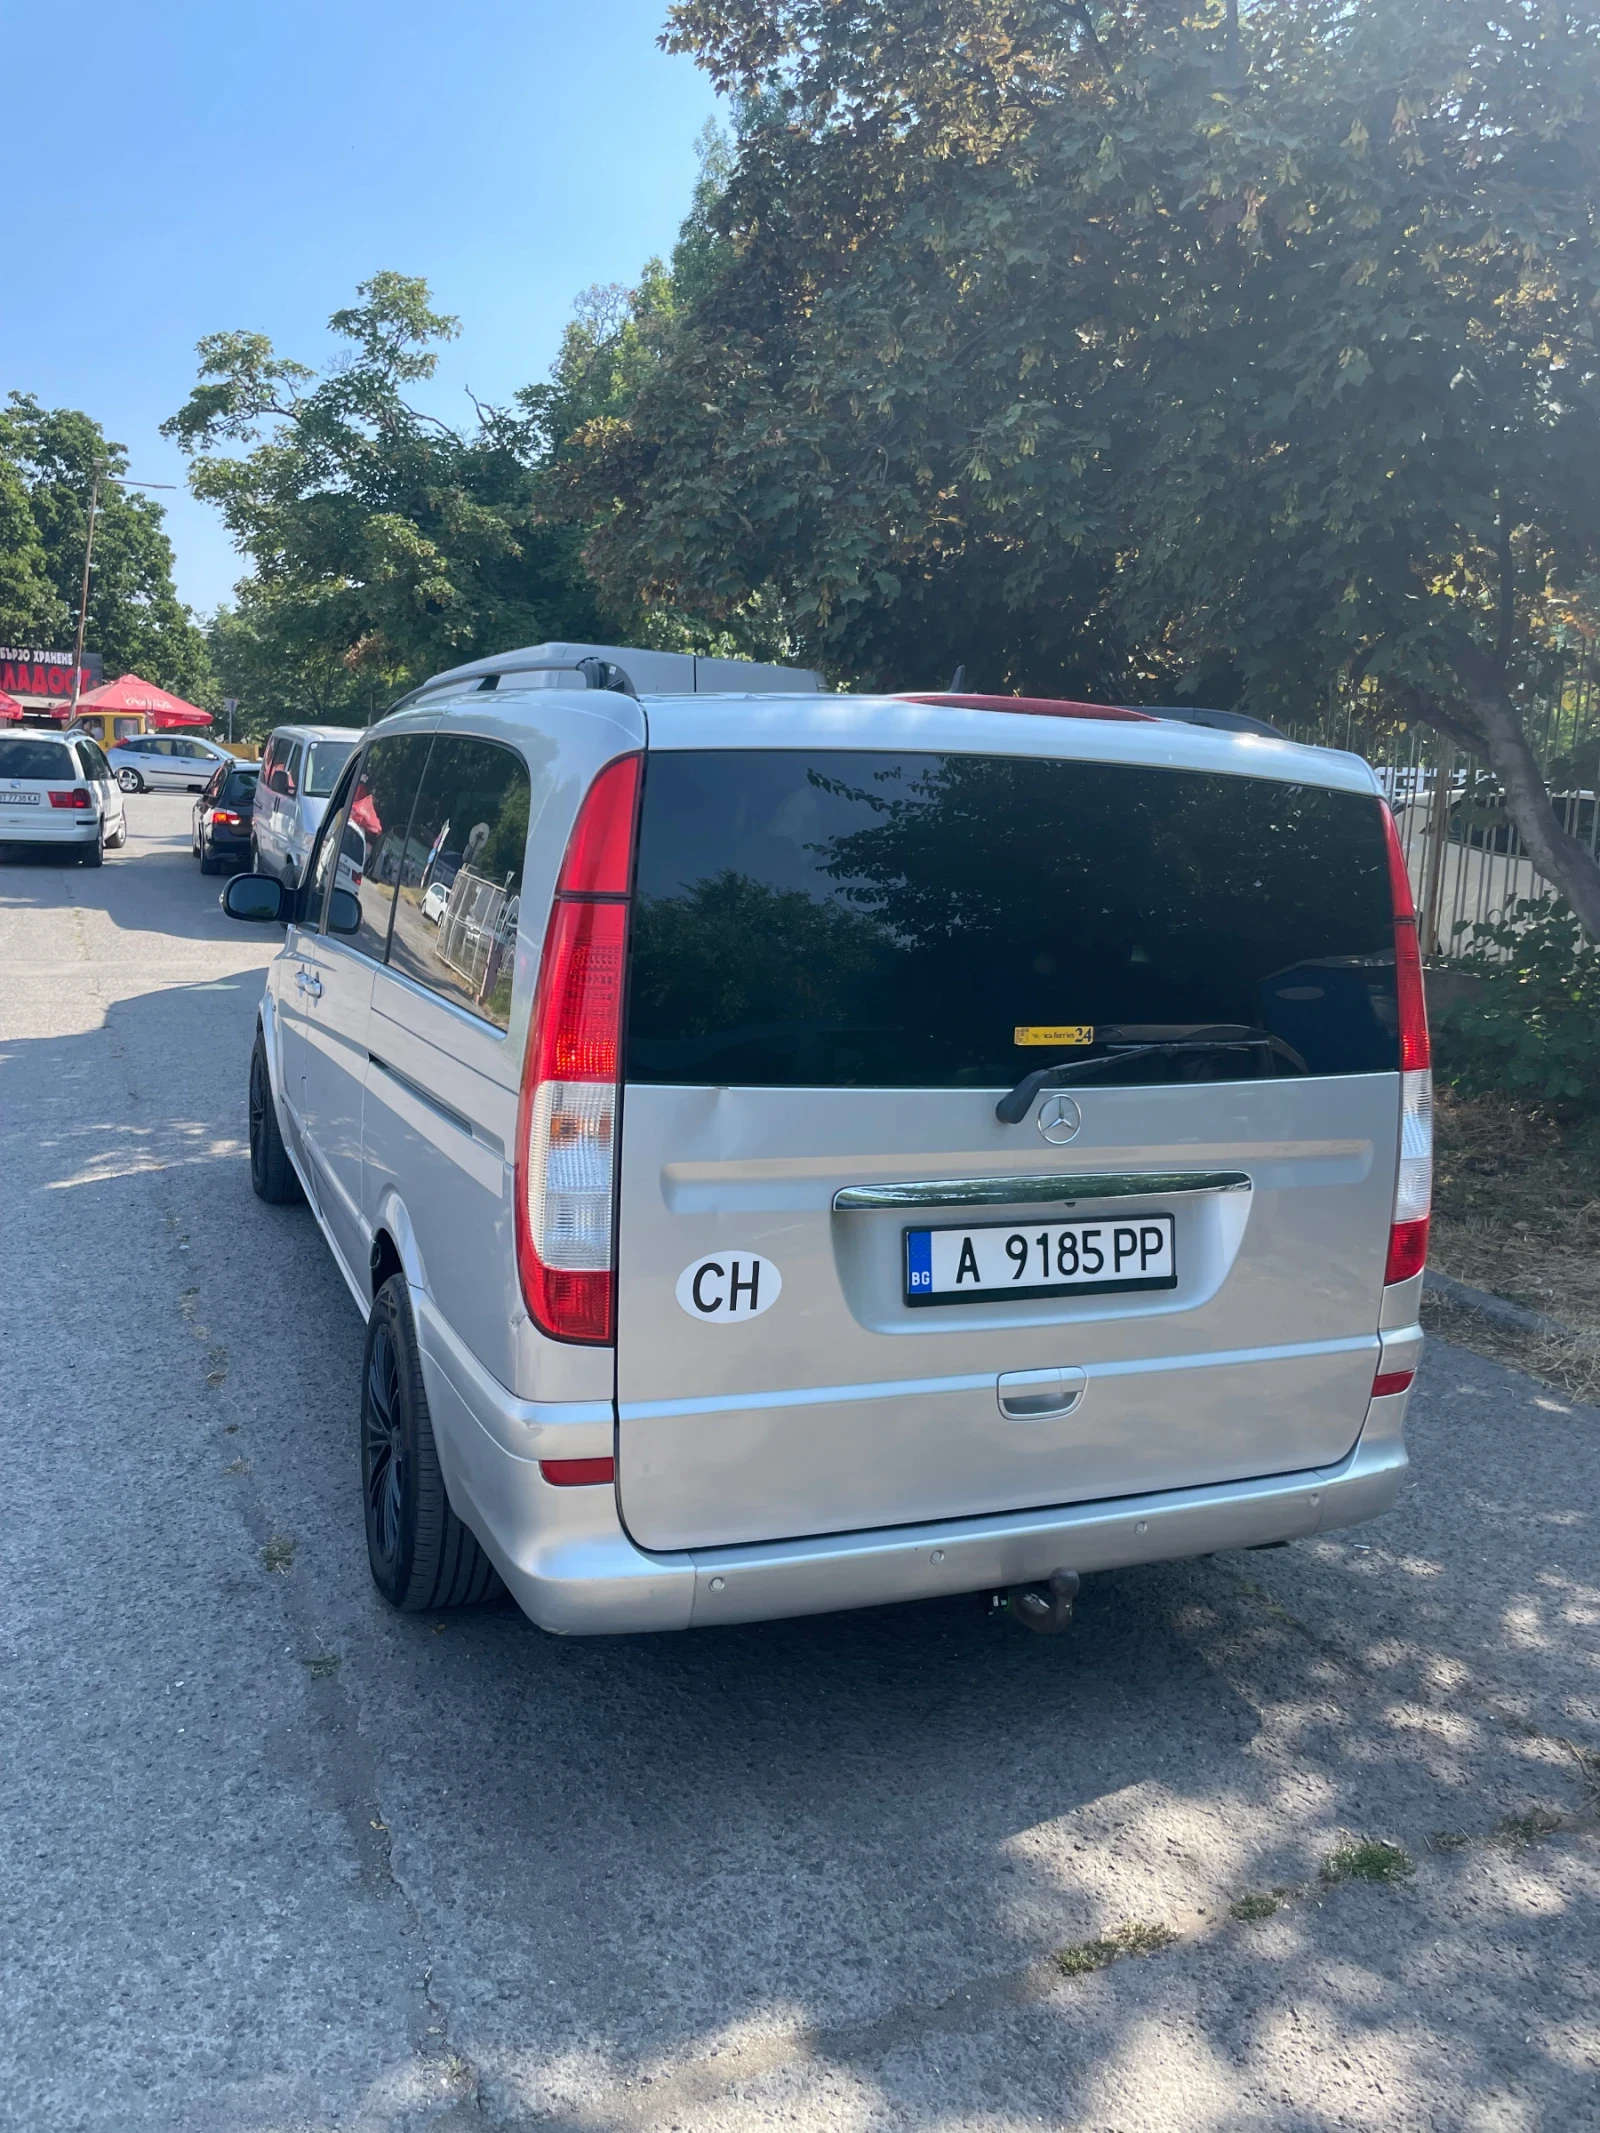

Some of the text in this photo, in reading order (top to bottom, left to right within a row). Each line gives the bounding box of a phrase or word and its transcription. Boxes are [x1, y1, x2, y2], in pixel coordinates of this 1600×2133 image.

[33, 650, 74, 666] ХРАНЕНЕ
[0, 662, 92, 696] ЛАДОСТ
[1075, 1027, 1092, 1043] 24
[956, 1236, 981, 1284] A
[692, 1260, 761, 1313] CH
[911, 1271, 931, 1286] BG
